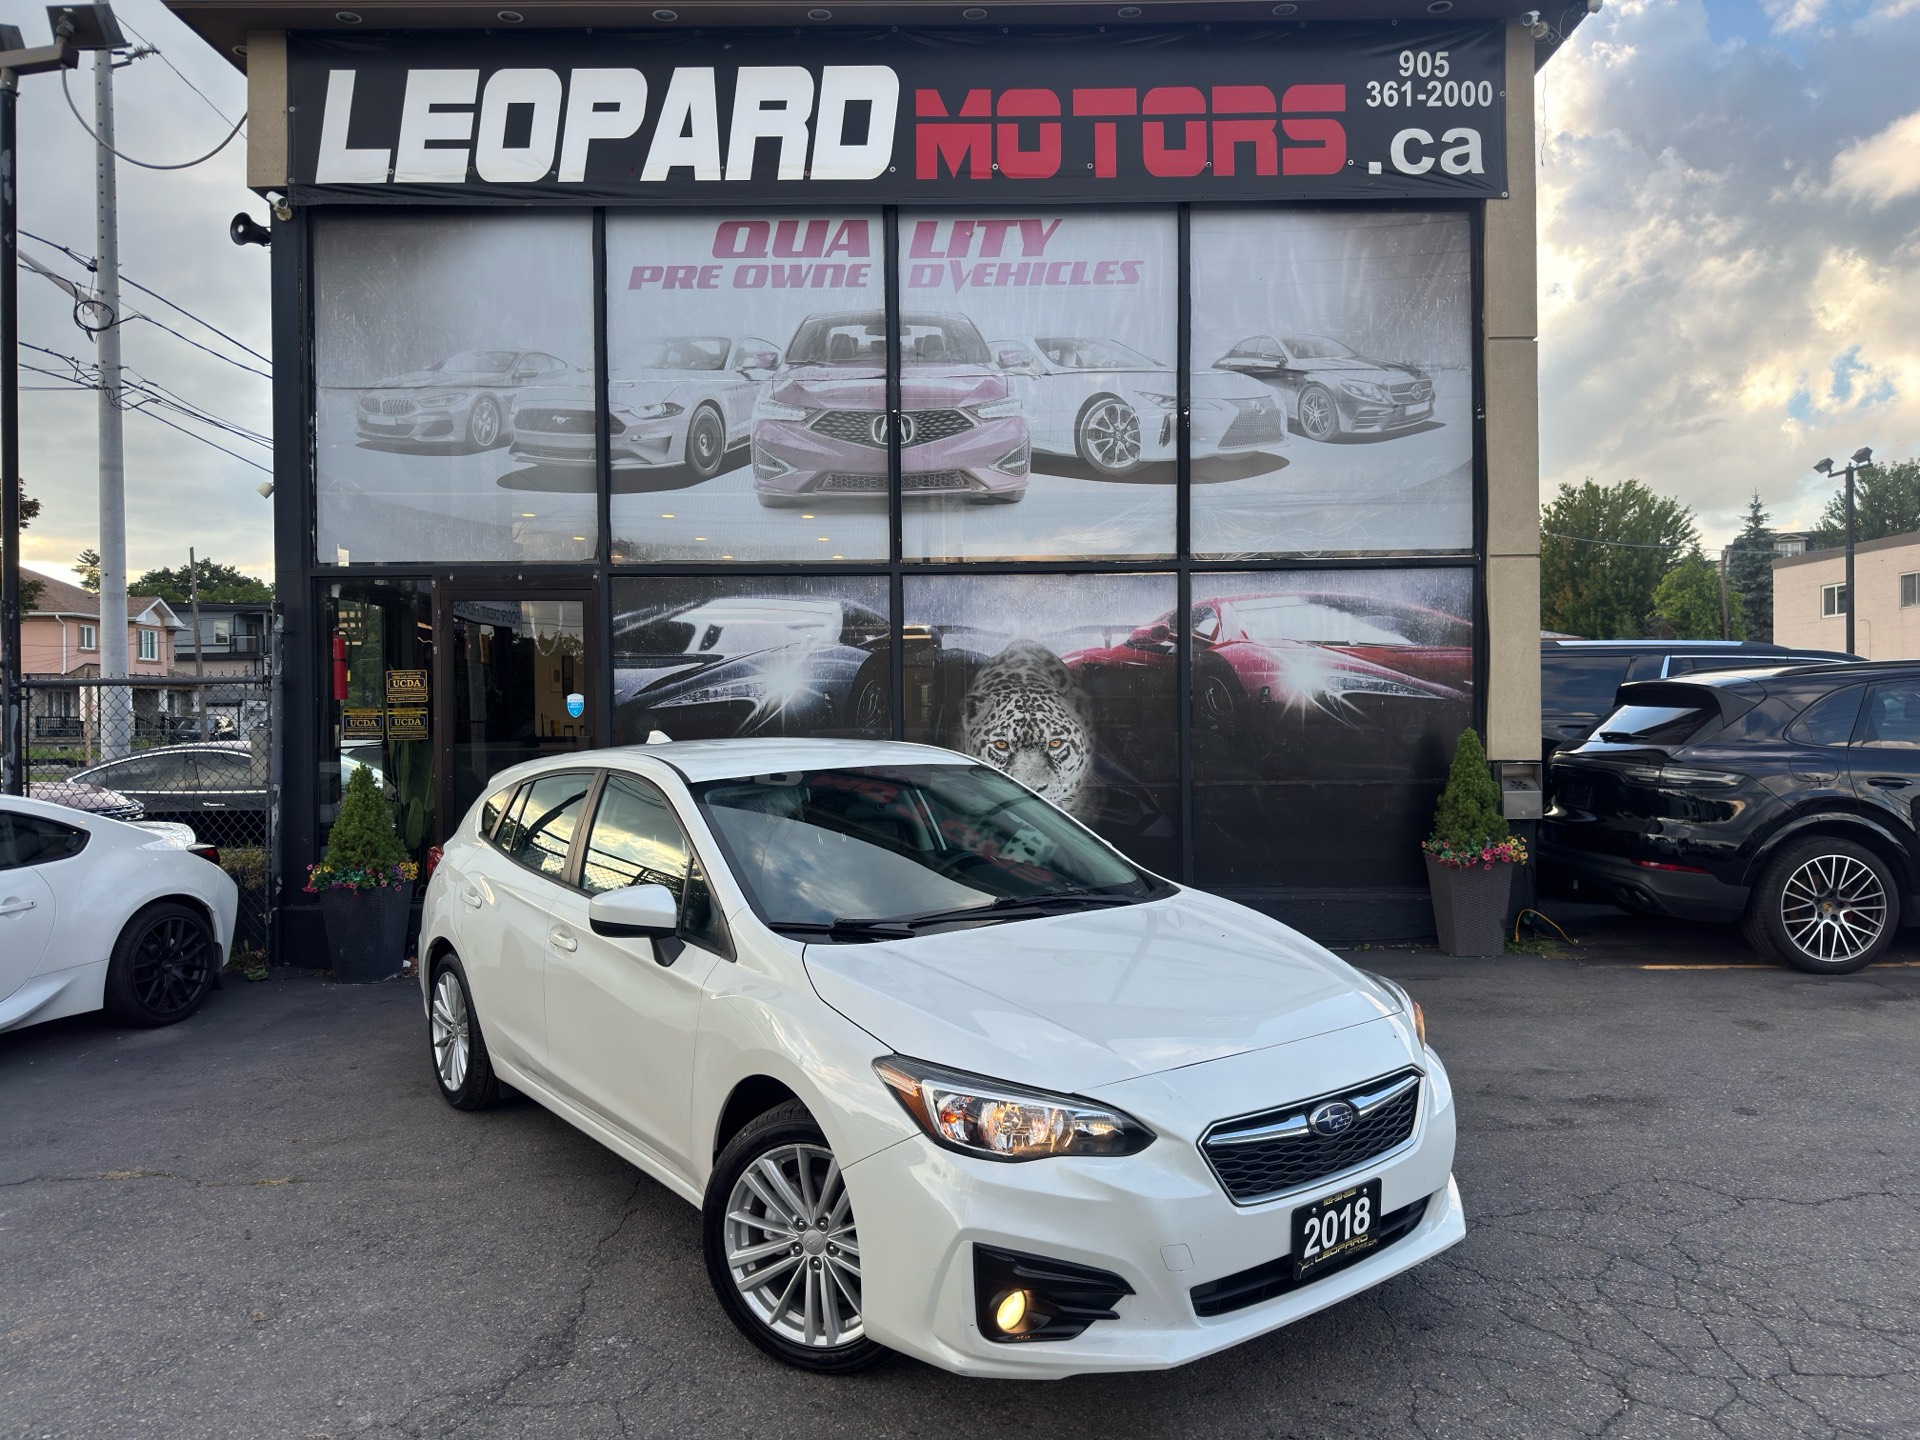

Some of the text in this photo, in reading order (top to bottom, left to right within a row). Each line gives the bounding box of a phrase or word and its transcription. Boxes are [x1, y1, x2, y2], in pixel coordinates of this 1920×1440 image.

[1398, 50, 1450, 78] 905
[1365, 80, 1494, 108] 361-2000
[315, 65, 1485, 184] LEOPARD MOTORS .ca
[711, 218, 1063, 259] QUA LITY
[627, 265, 724, 290] PRE
[731, 263, 872, 290] OWNE
[393, 679, 421, 688] UCDA
[350, 719, 377, 727] UCDA
[394, 718, 421, 726] UCDA
[1303, 1196, 1371, 1259] 2018
[1314, 1233, 1369, 1263] LEOPARD
